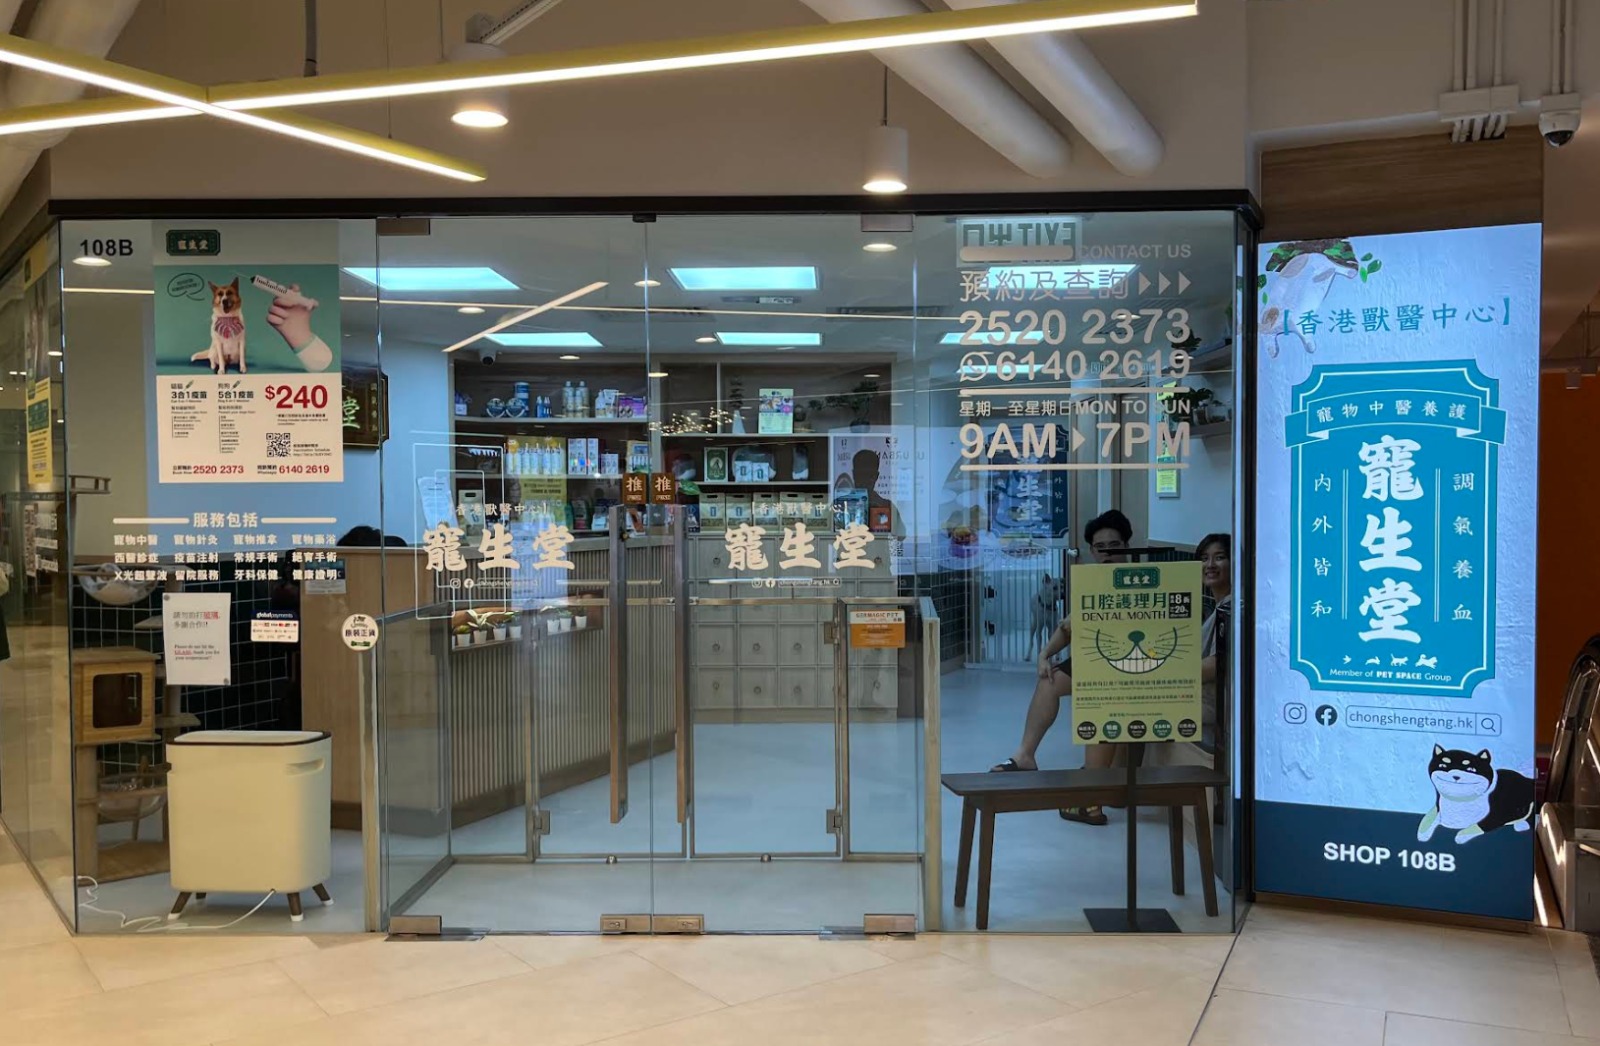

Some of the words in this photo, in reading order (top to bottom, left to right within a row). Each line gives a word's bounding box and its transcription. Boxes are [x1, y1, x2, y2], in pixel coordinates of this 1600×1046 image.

[80, 239, 133, 256] 108B
[1080, 245, 1162, 258] CONTACT
[1167, 244, 1191, 258] US
[960, 269, 1128, 302] 預約及查詢
[959, 309, 1066, 345] 2520
[1082, 308, 1190, 344] 2373
[996, 350, 1085, 381] 6140
[1099, 349, 1190, 380] 2619
[265, 385, 328, 409] $240
[959, 401, 1070, 417] 星期一至星期日
[1075, 400, 1117, 415] MON
[1122, 400, 1147, 414] TO
[1316, 399, 1467, 423] 寵物中醫養護
[959, 423, 1056, 459] 9AM
[1097, 422, 1190, 458] 7PM
[193, 465, 217, 474] 2520
[220, 465, 244, 474] 2373
[279, 465, 303, 474] 6140
[305, 465, 330, 474] 2619
[626, 476, 643, 492] 推
[655, 476, 672, 492] 推
[193, 512, 258, 528] 服務包括
[114, 534, 157, 545] 寵物中醫
[174, 534, 218, 545] 寵物針灸
[423, 521, 575, 571] 寵生堂
[725, 522, 875, 570] 寵生堂
[1358, 434, 1424, 644] 寵生堂
[1452, 472, 1474, 621] 調氣養血
[175, 552, 218, 563] 疫苗注射
[1081, 592, 1166, 611] 口腔護理月
[1082, 612, 1124, 622] DENTAL
[1127, 610, 1166, 621] MONTH
[1329, 668, 1362, 677] Member
[1376, 671, 1393, 679] PET
[1395, 672, 1422, 680] SPACE
[1424, 673, 1452, 682] Group
[1349, 711, 1473, 730] chongshengtang.hk
[1323, 842, 1391, 865] SHOP
[1398, 850, 1456, 872] 108B
